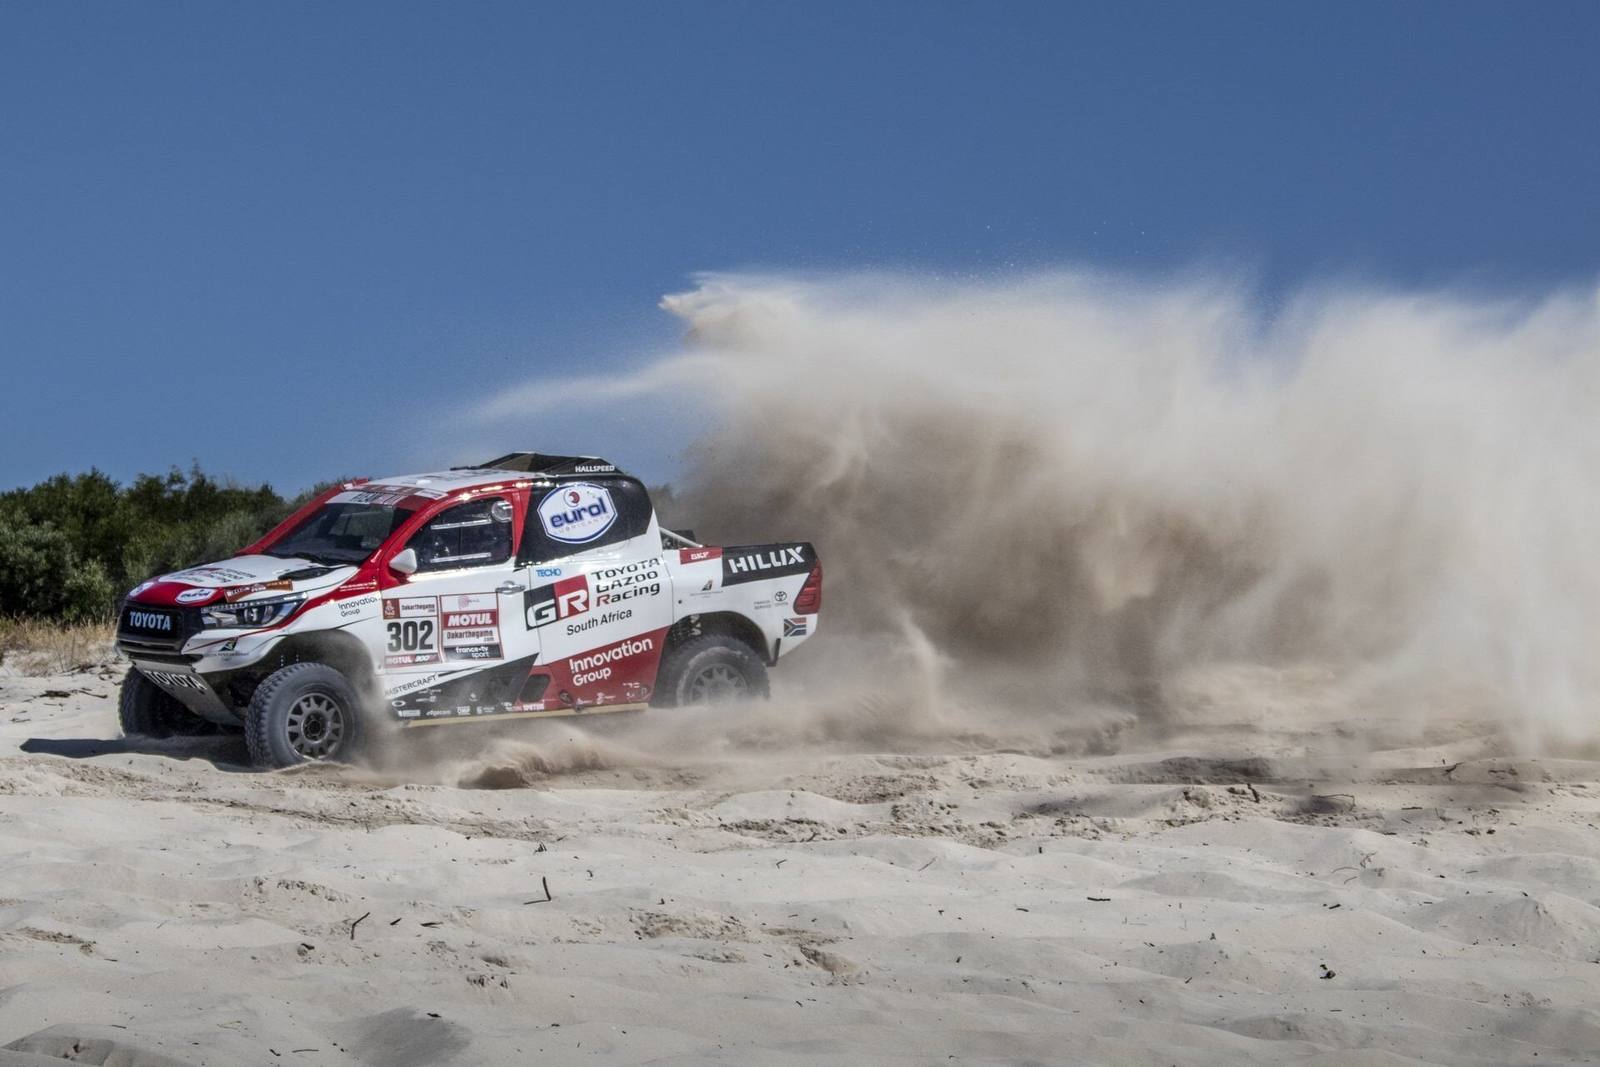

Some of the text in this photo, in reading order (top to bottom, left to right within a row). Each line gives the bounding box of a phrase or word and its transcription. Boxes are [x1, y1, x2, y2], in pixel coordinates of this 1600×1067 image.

[575, 465, 615, 473] HALLSPEED
[550, 497, 607, 528] eurol
[690, 551, 710, 560] SKF
[728, 546, 805, 574] HILUX
[536, 568, 562, 577] TECHO
[591, 557, 661, 580] TOYOTA
[595, 570, 658, 594] GAZOO
[596, 582, 661, 607] Racing
[447, 612, 493, 627] MOTUL
[526, 589, 588, 628] GR
[129, 611, 171, 631] TOYOTA
[567, 609, 633, 636] South Africa
[387, 620, 434, 652] 302
[447, 630, 494, 640] Dakarthegame
[569, 638, 653, 673] Innovation
[143, 669, 208, 691] TOYOTA
[572, 667, 612, 687] Group
